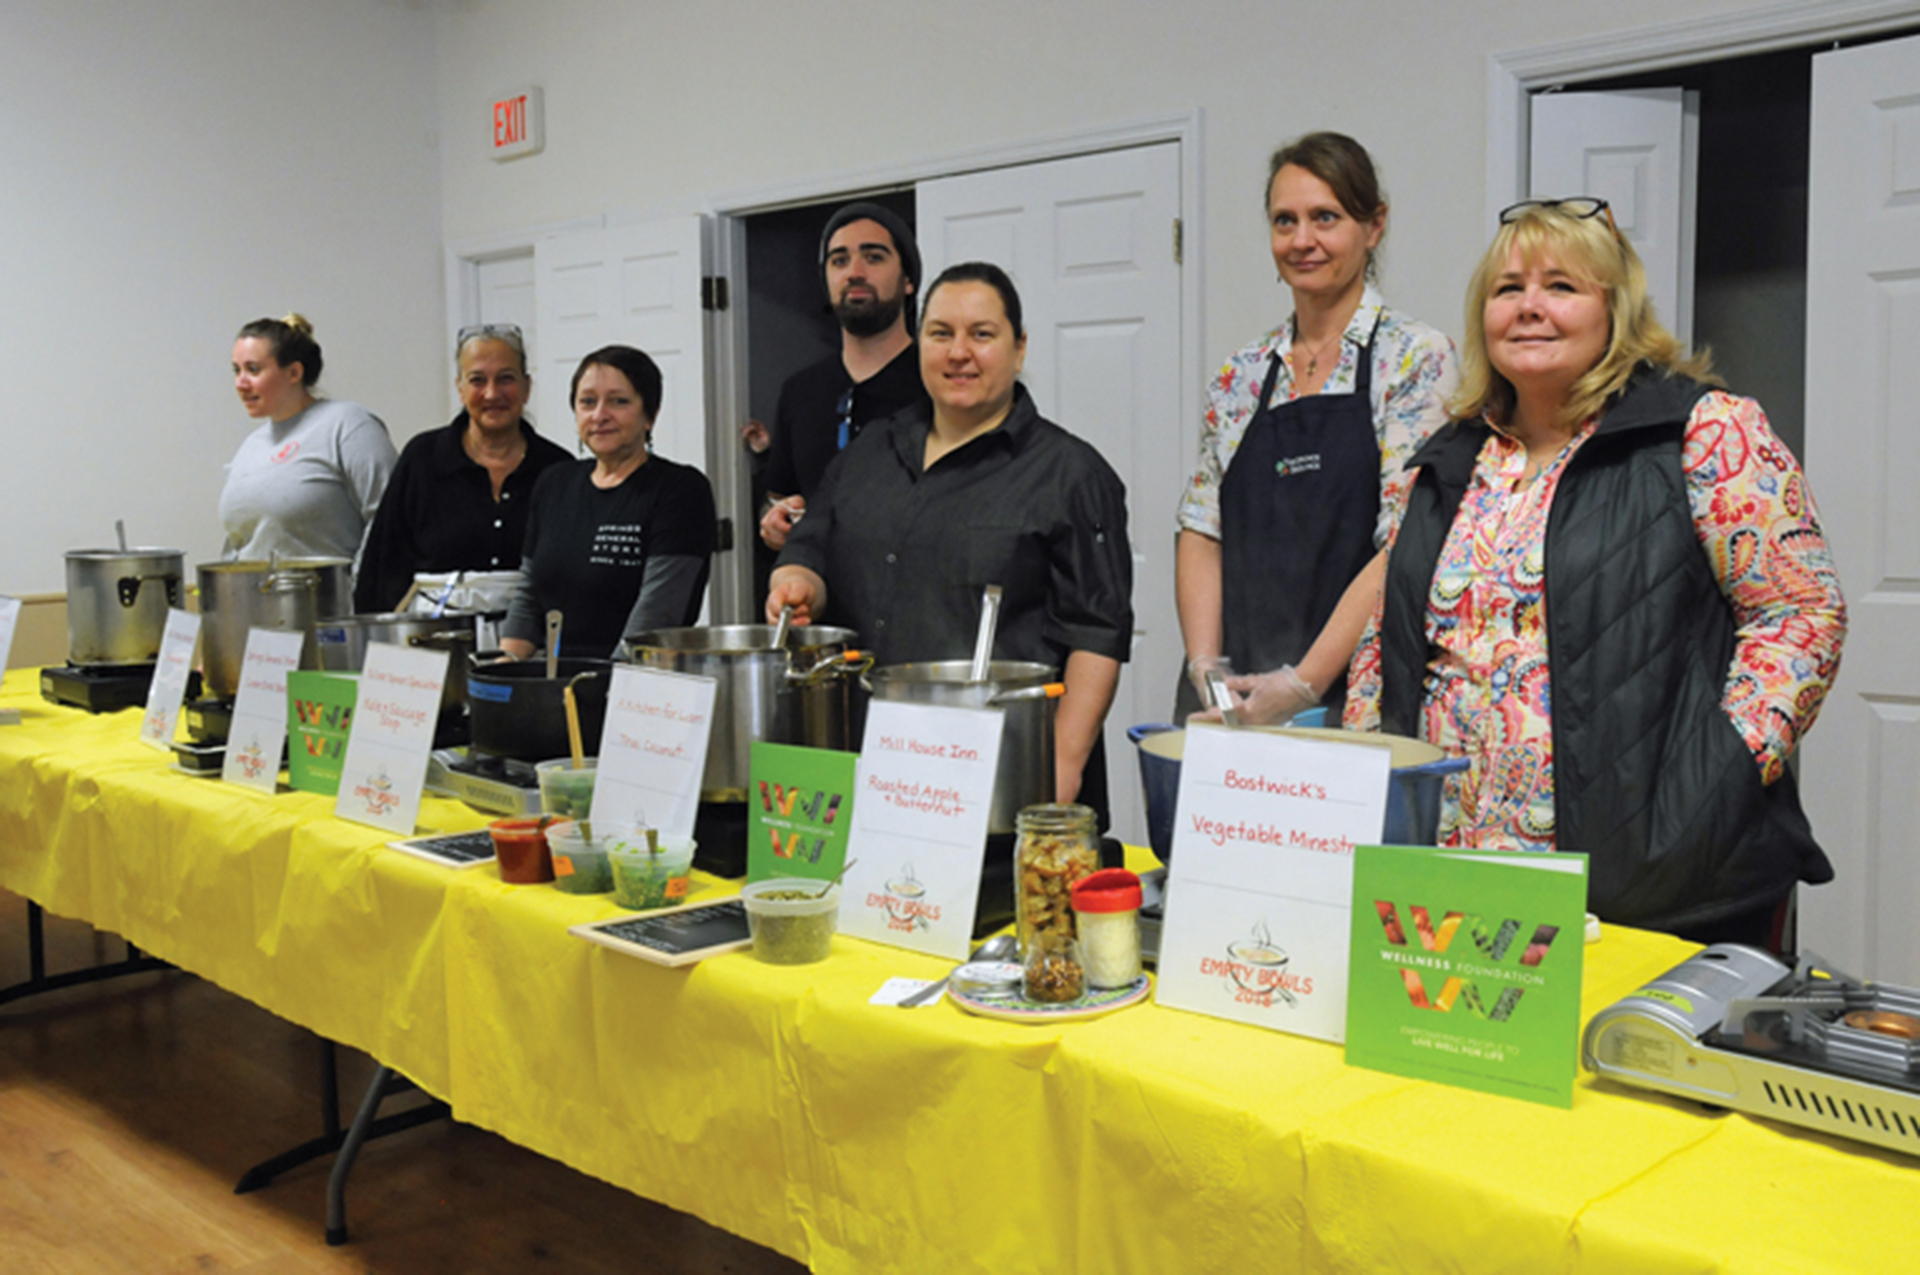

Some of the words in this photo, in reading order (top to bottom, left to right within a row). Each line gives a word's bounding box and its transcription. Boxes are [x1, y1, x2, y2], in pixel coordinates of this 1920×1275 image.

[493, 94, 527, 148] EXIT
[879, 735, 905, 751] Mill
[908, 739, 946, 757] House
[950, 744, 979, 760] Inn
[868, 774, 920, 796] Roasted
[922, 784, 961, 805] Apple
[1224, 769, 1327, 800] Bostwick's
[894, 792, 965, 817] Butternut
[1191, 813, 1284, 847] Vegetable
[866, 892, 902, 912] EMPTY
[1200, 957, 1255, 982] EMPTY
[1256, 968, 1313, 995] BOWLS
[1380, 949, 1451, 971] WELLNESS
[1456, 962, 1544, 986] FOUNDATION
[1234, 984, 1273, 1008] 2018
[1400, 1026, 1465, 1046] EMPOWERING
[1467, 1037, 1503, 1051] PEOPLE
[1506, 1044, 1520, 1057] TO
[1412, 1036, 1433, 1049] LIVE
[1434, 1041, 1460, 1055] WELL
[1461, 1045, 1482, 1058] FOR
[1483, 1050, 1505, 1063] LIFE
